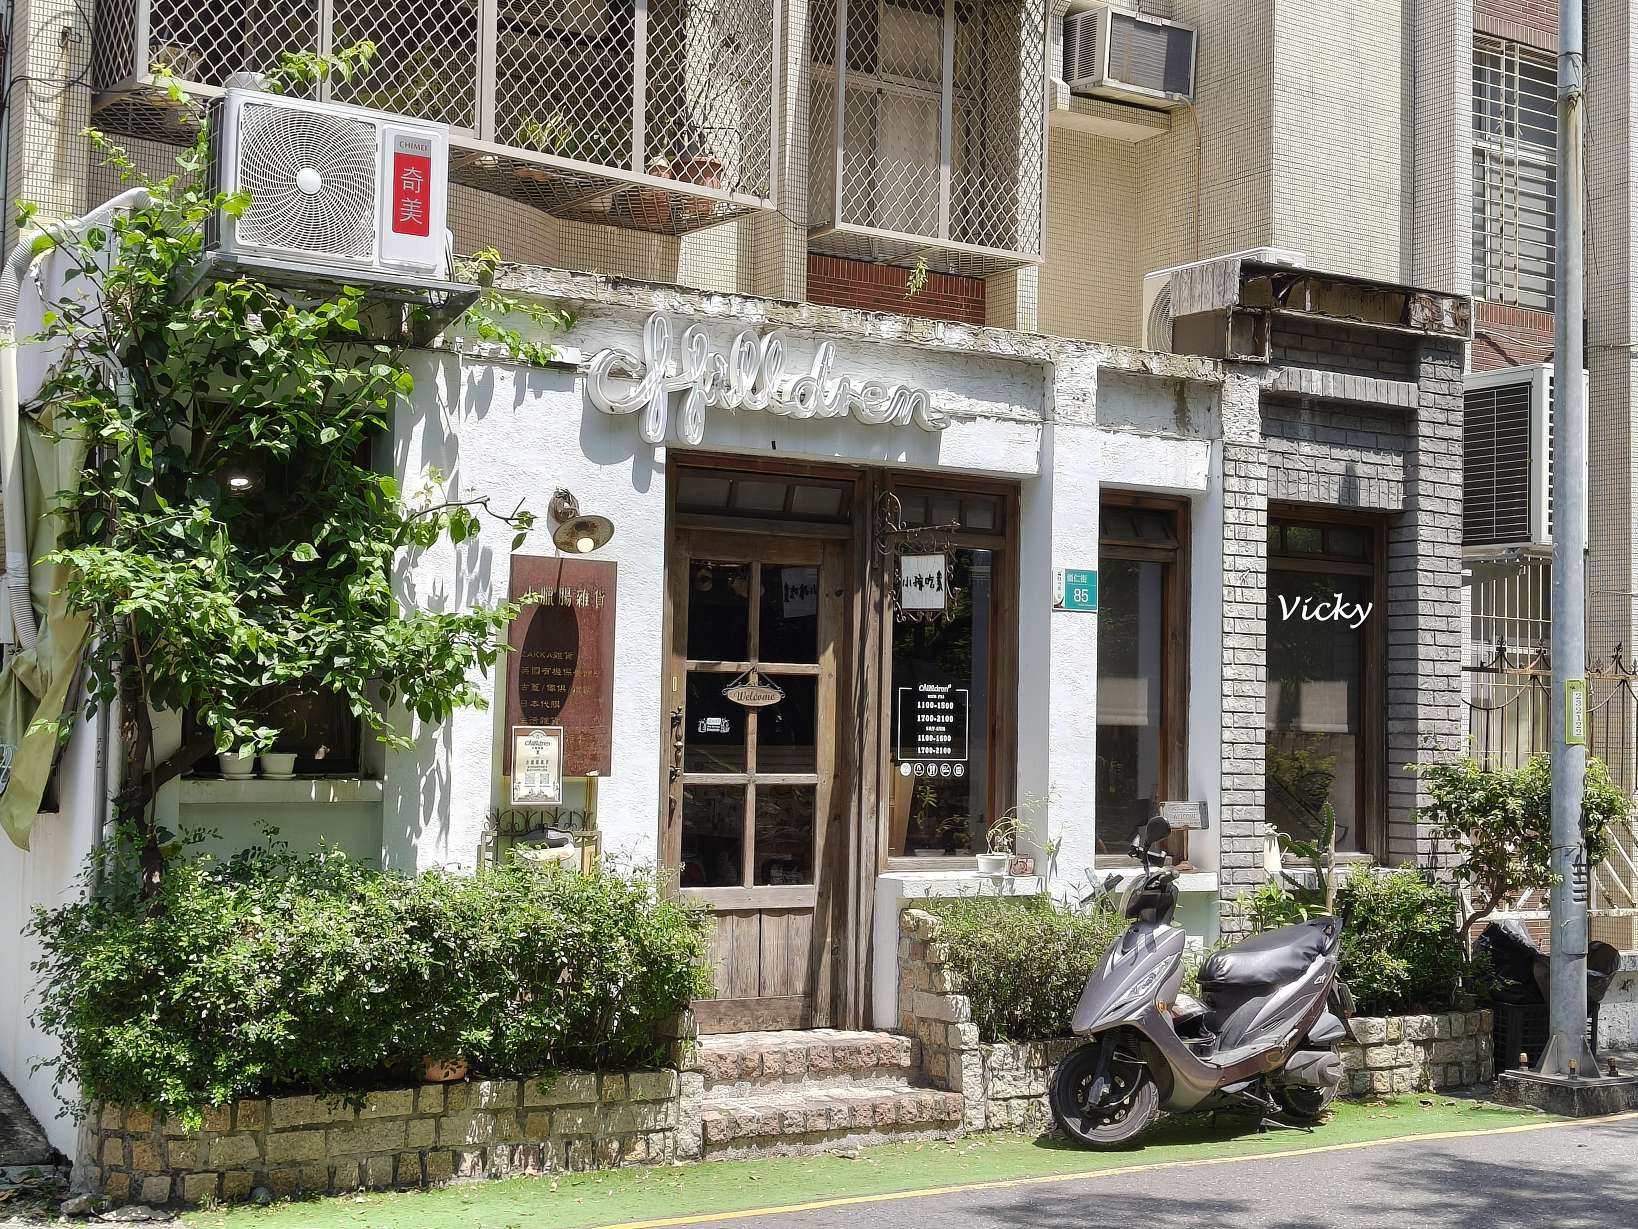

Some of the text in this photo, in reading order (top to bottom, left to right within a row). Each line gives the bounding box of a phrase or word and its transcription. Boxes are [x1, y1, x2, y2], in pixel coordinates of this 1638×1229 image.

[399, 141, 428, 152] CHIMEI
[399, 166, 424, 225] 奇美
[1073, 588, 1089, 603] 85
[735, 690, 775, 702] Welcome
[917, 714, 954, 723] 1700-2100
